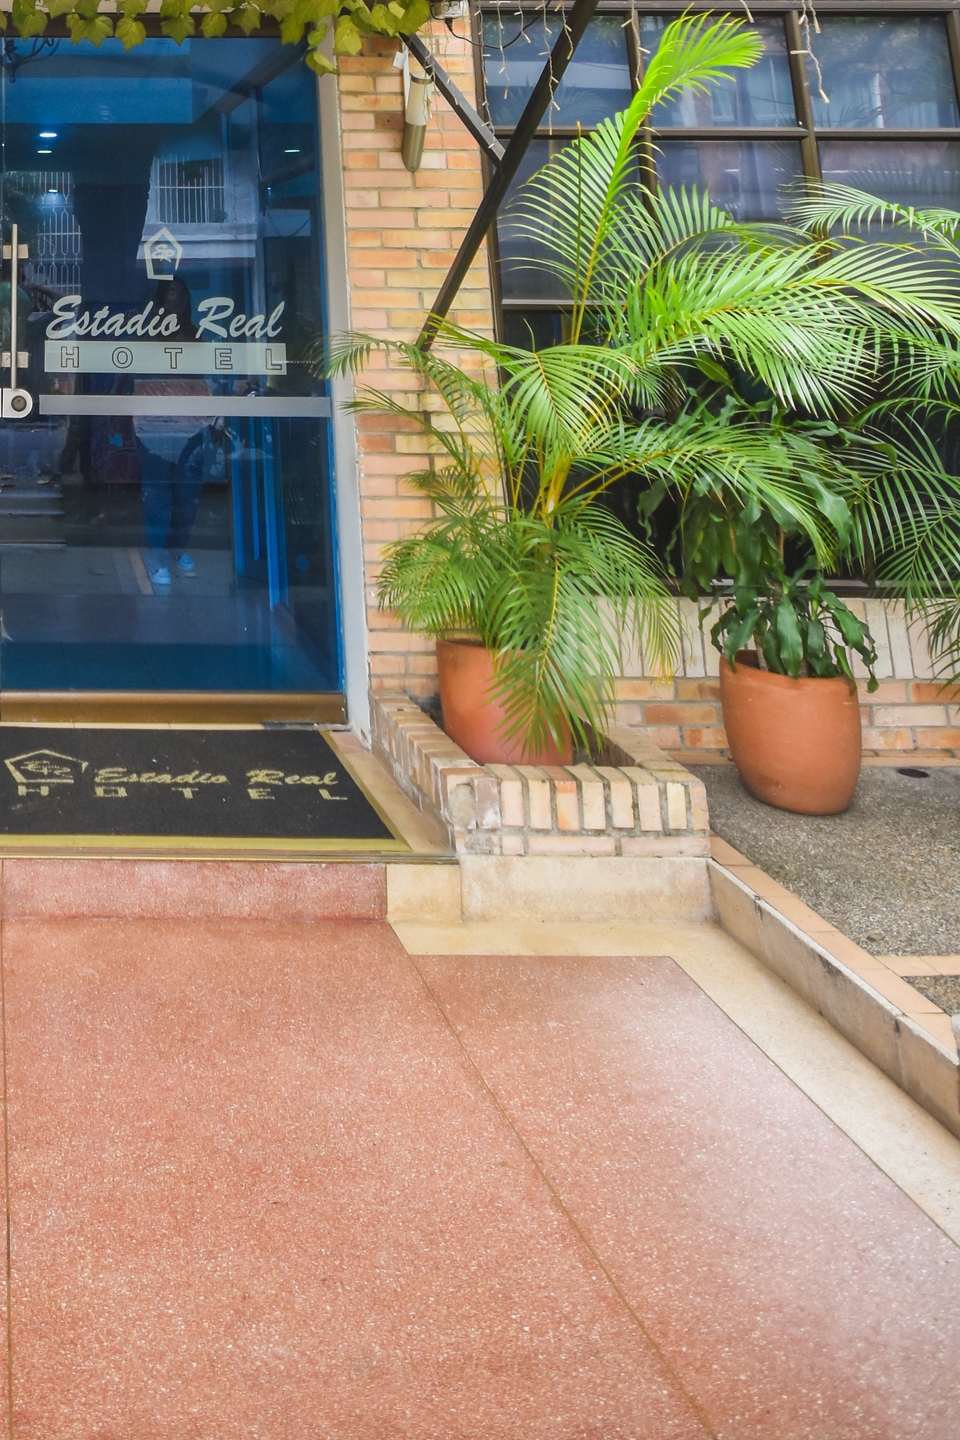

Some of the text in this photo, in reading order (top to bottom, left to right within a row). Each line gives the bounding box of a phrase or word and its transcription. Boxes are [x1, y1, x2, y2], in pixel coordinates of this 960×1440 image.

[45, 294, 286, 340] Estadio Real
[60, 346, 283, 371] HOTEL
[246, 769, 339, 785] Real
[17, 785, 348, 800] HOTEL
